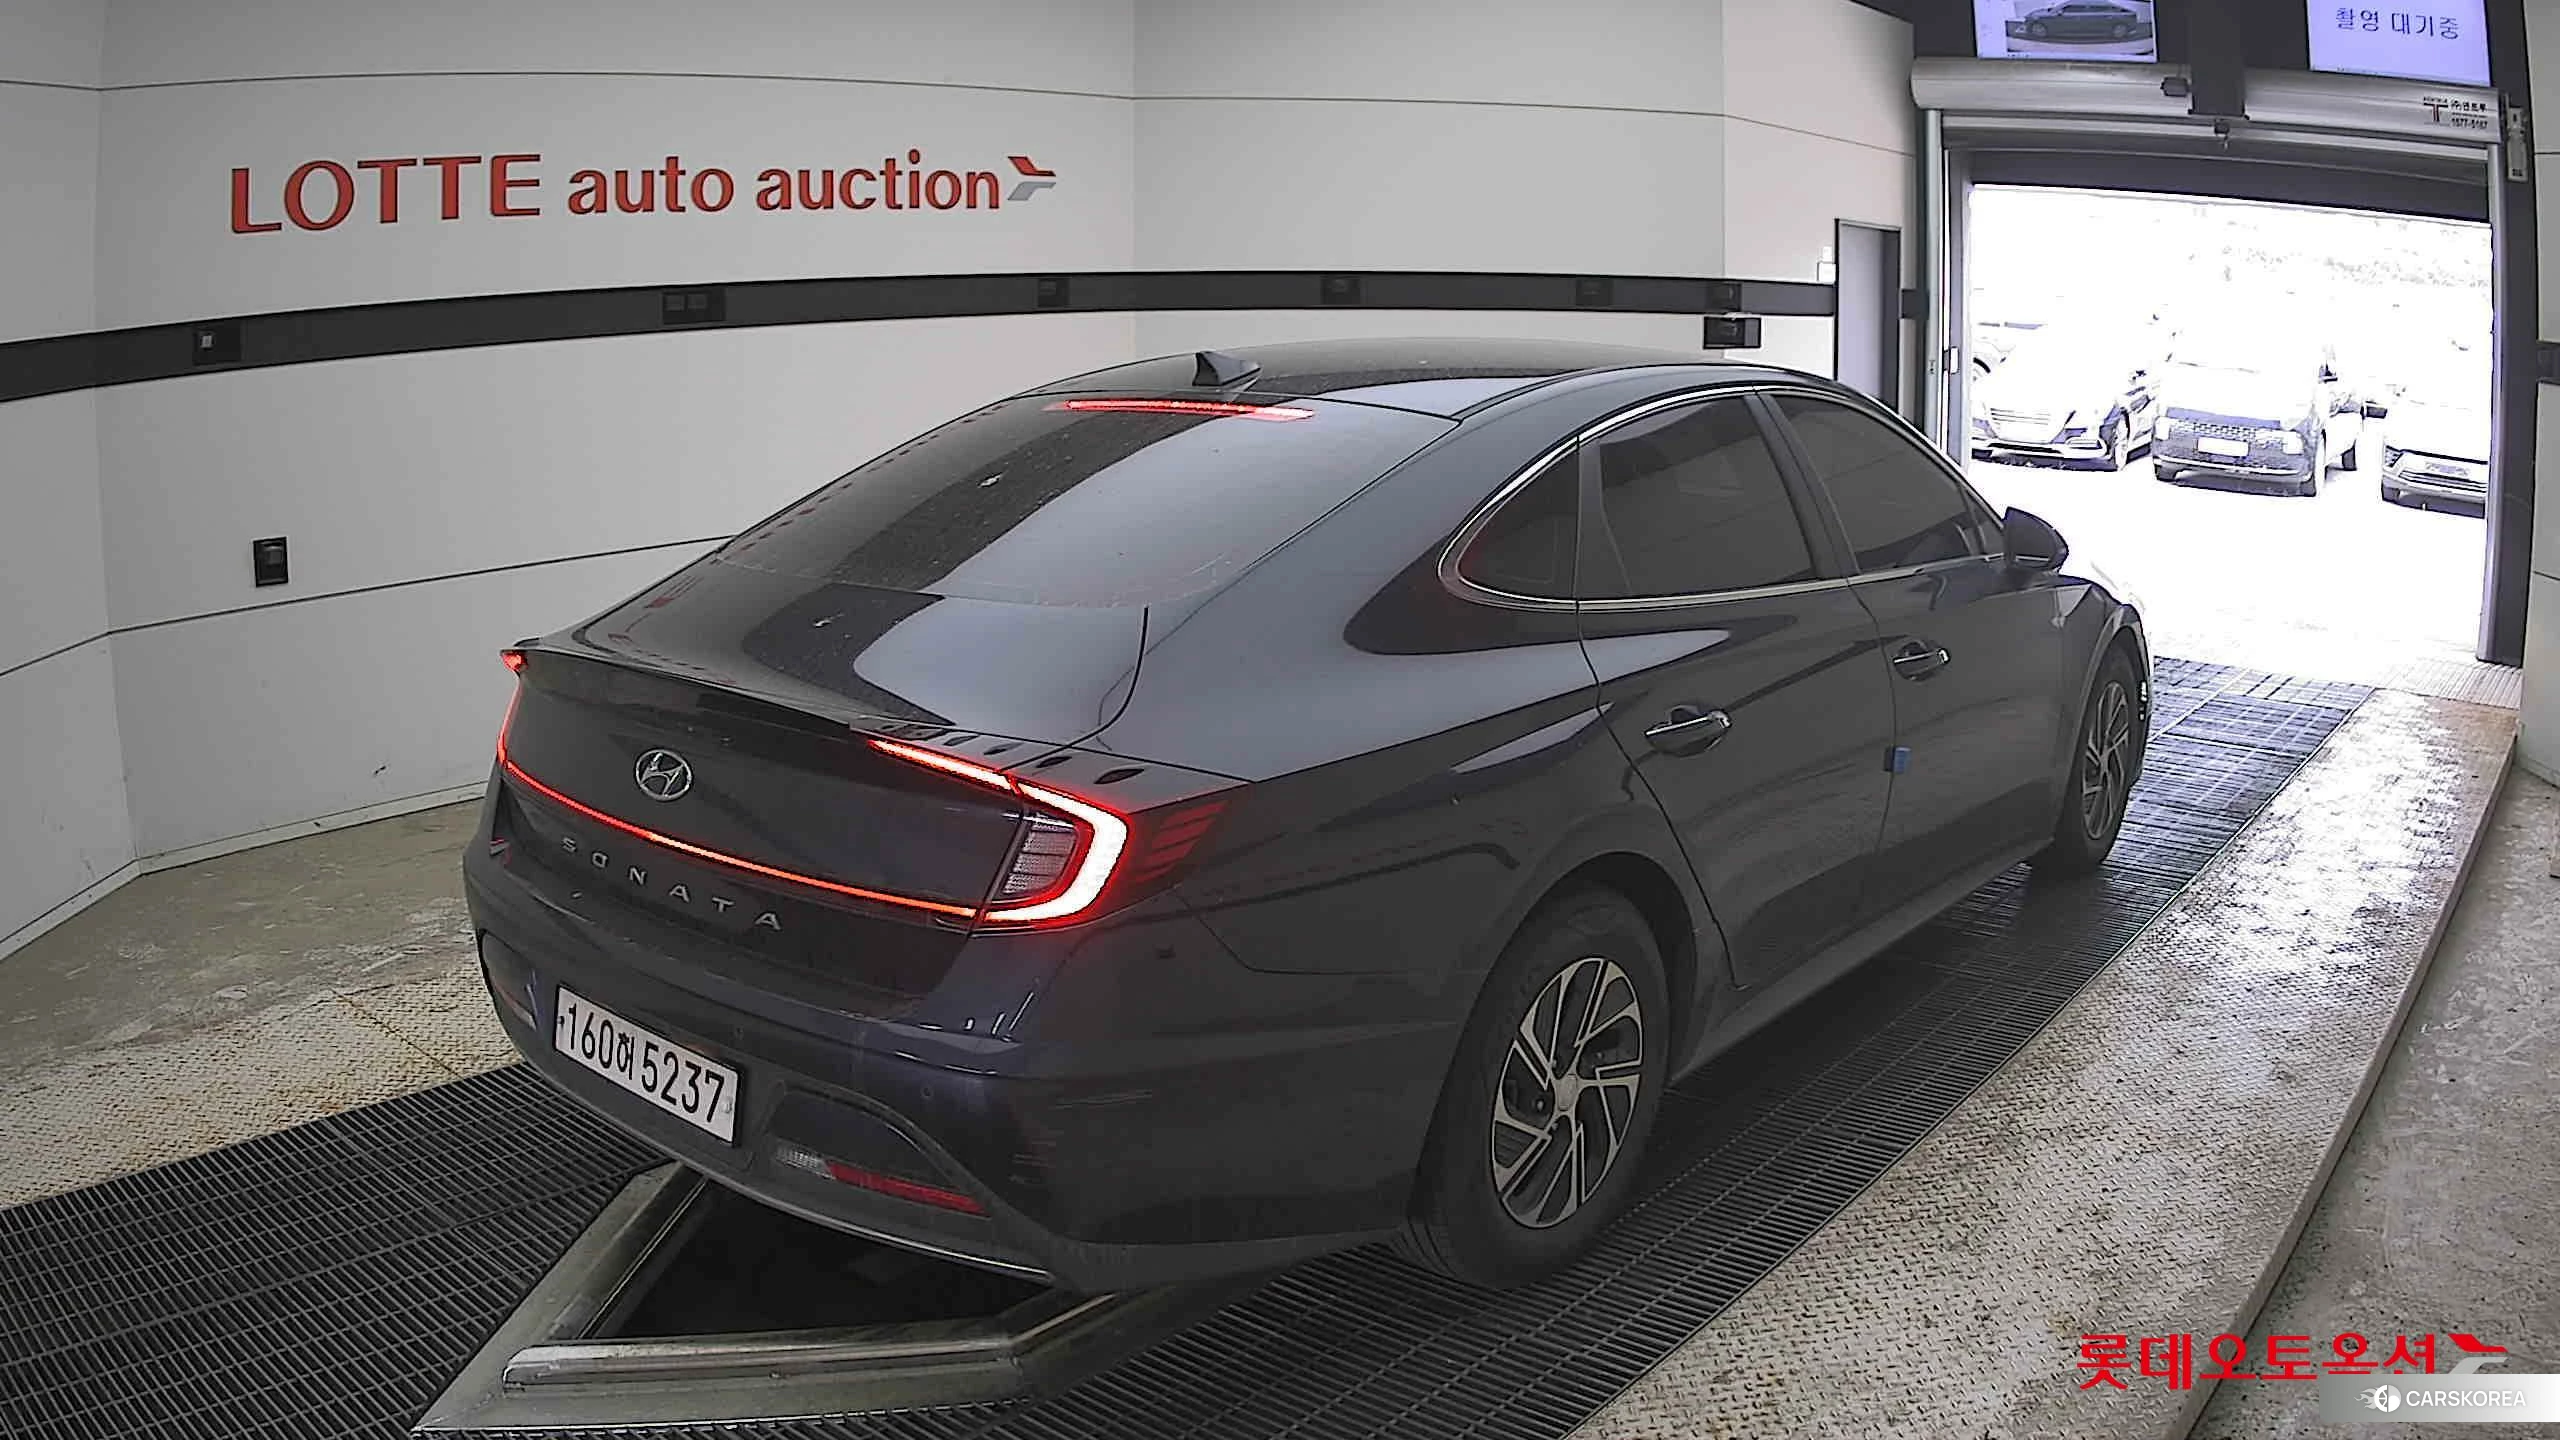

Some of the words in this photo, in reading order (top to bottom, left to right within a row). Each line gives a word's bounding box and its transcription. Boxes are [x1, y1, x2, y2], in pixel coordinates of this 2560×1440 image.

[2335, 7, 2379, 32] 촬영
[231, 153, 541, 234] LOTTE
[567, 155, 735, 216] auto
[756, 148, 1000, 212] auction
[562, 836, 782, 931] SONATA
